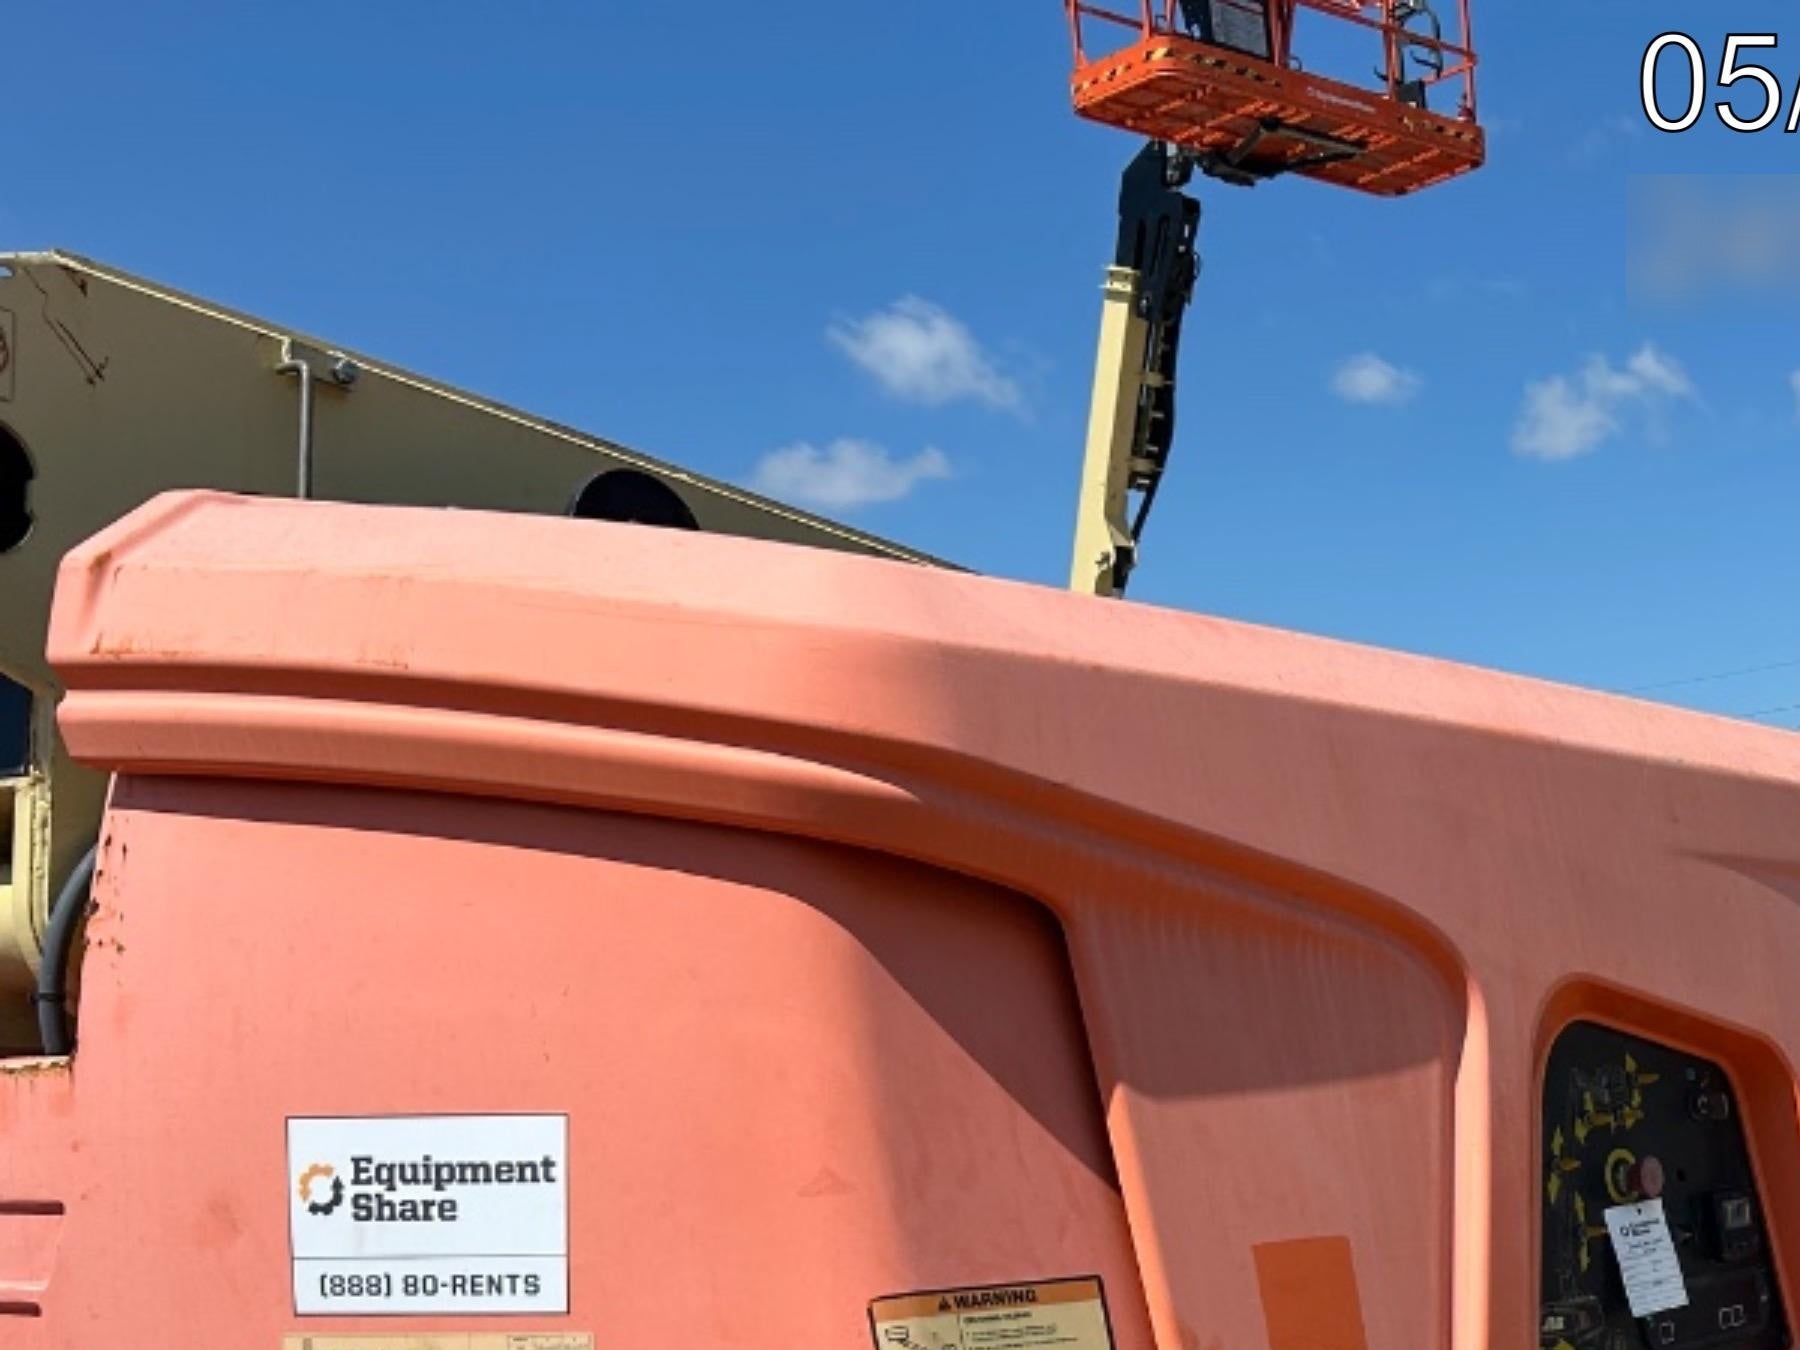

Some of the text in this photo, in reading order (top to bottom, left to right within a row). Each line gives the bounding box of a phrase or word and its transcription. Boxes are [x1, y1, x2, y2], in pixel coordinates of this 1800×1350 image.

[350, 1155, 557, 1191] Equipment
[350, 1193, 458, 1222] Share
[319, 1273, 541, 1298] (888) 80-RENTS
